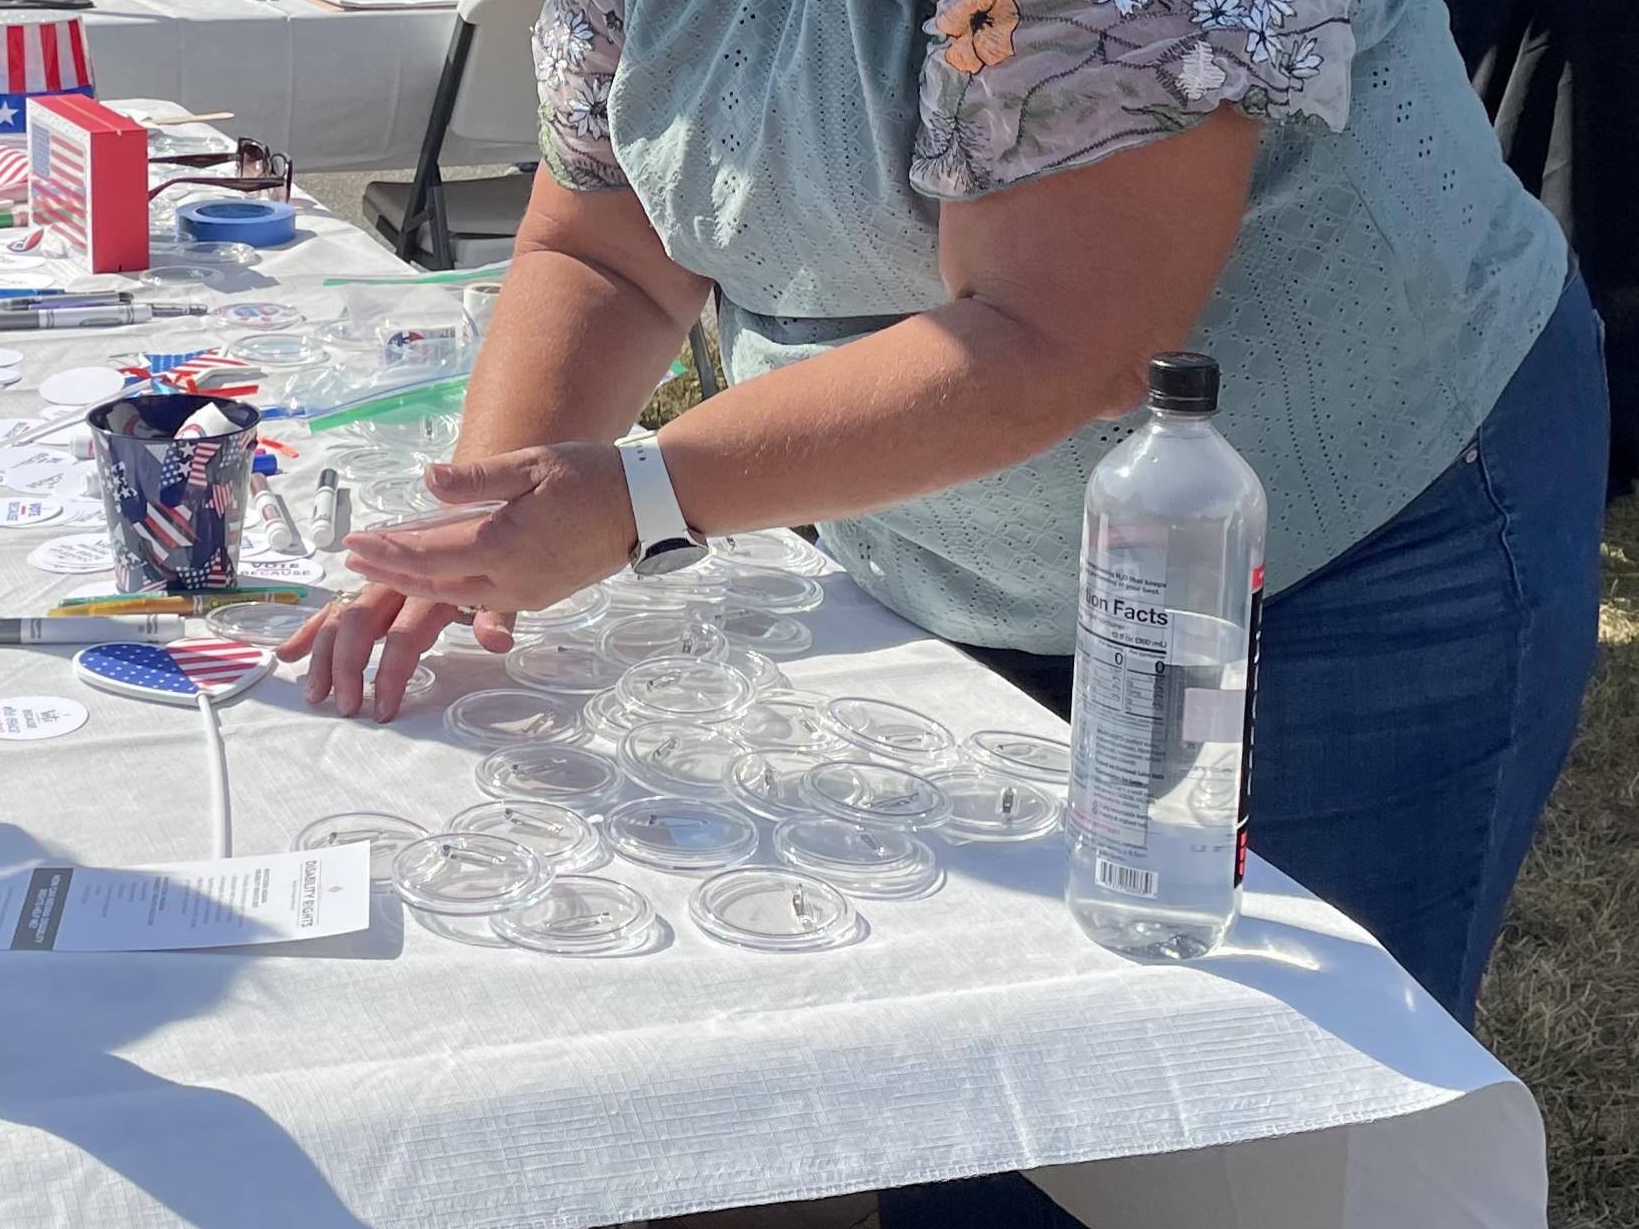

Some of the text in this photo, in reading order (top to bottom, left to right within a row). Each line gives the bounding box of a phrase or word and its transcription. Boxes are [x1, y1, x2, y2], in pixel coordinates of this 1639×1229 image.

[1084, 587, 1108, 613] tion
[1113, 599, 1168, 626] Facts
[1114, 652, 1166, 674] 0 0
